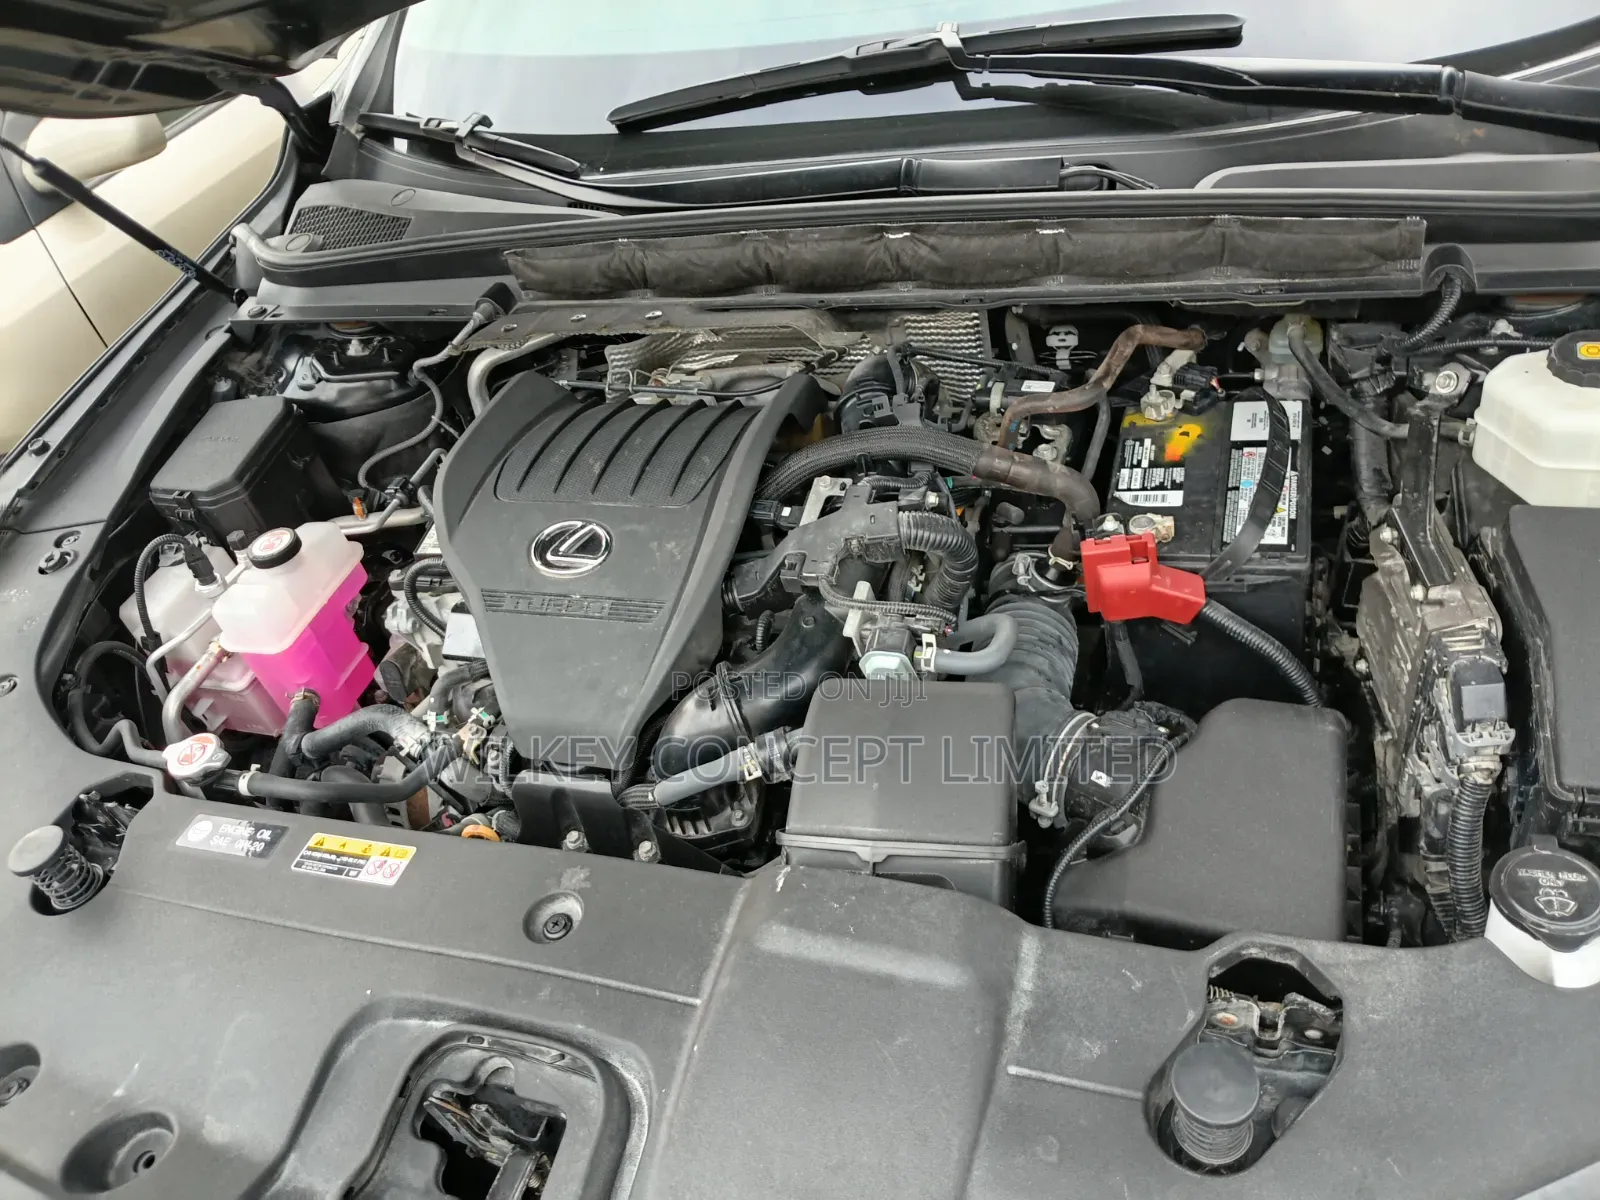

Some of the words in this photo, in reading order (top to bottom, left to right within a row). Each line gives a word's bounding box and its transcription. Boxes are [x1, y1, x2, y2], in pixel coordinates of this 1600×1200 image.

[509, 595, 610, 616] TURBO
[218, 823, 255, 837] ENGINE
[256, 829, 272, 840] OIL
[210, 835, 232, 846] SAE
